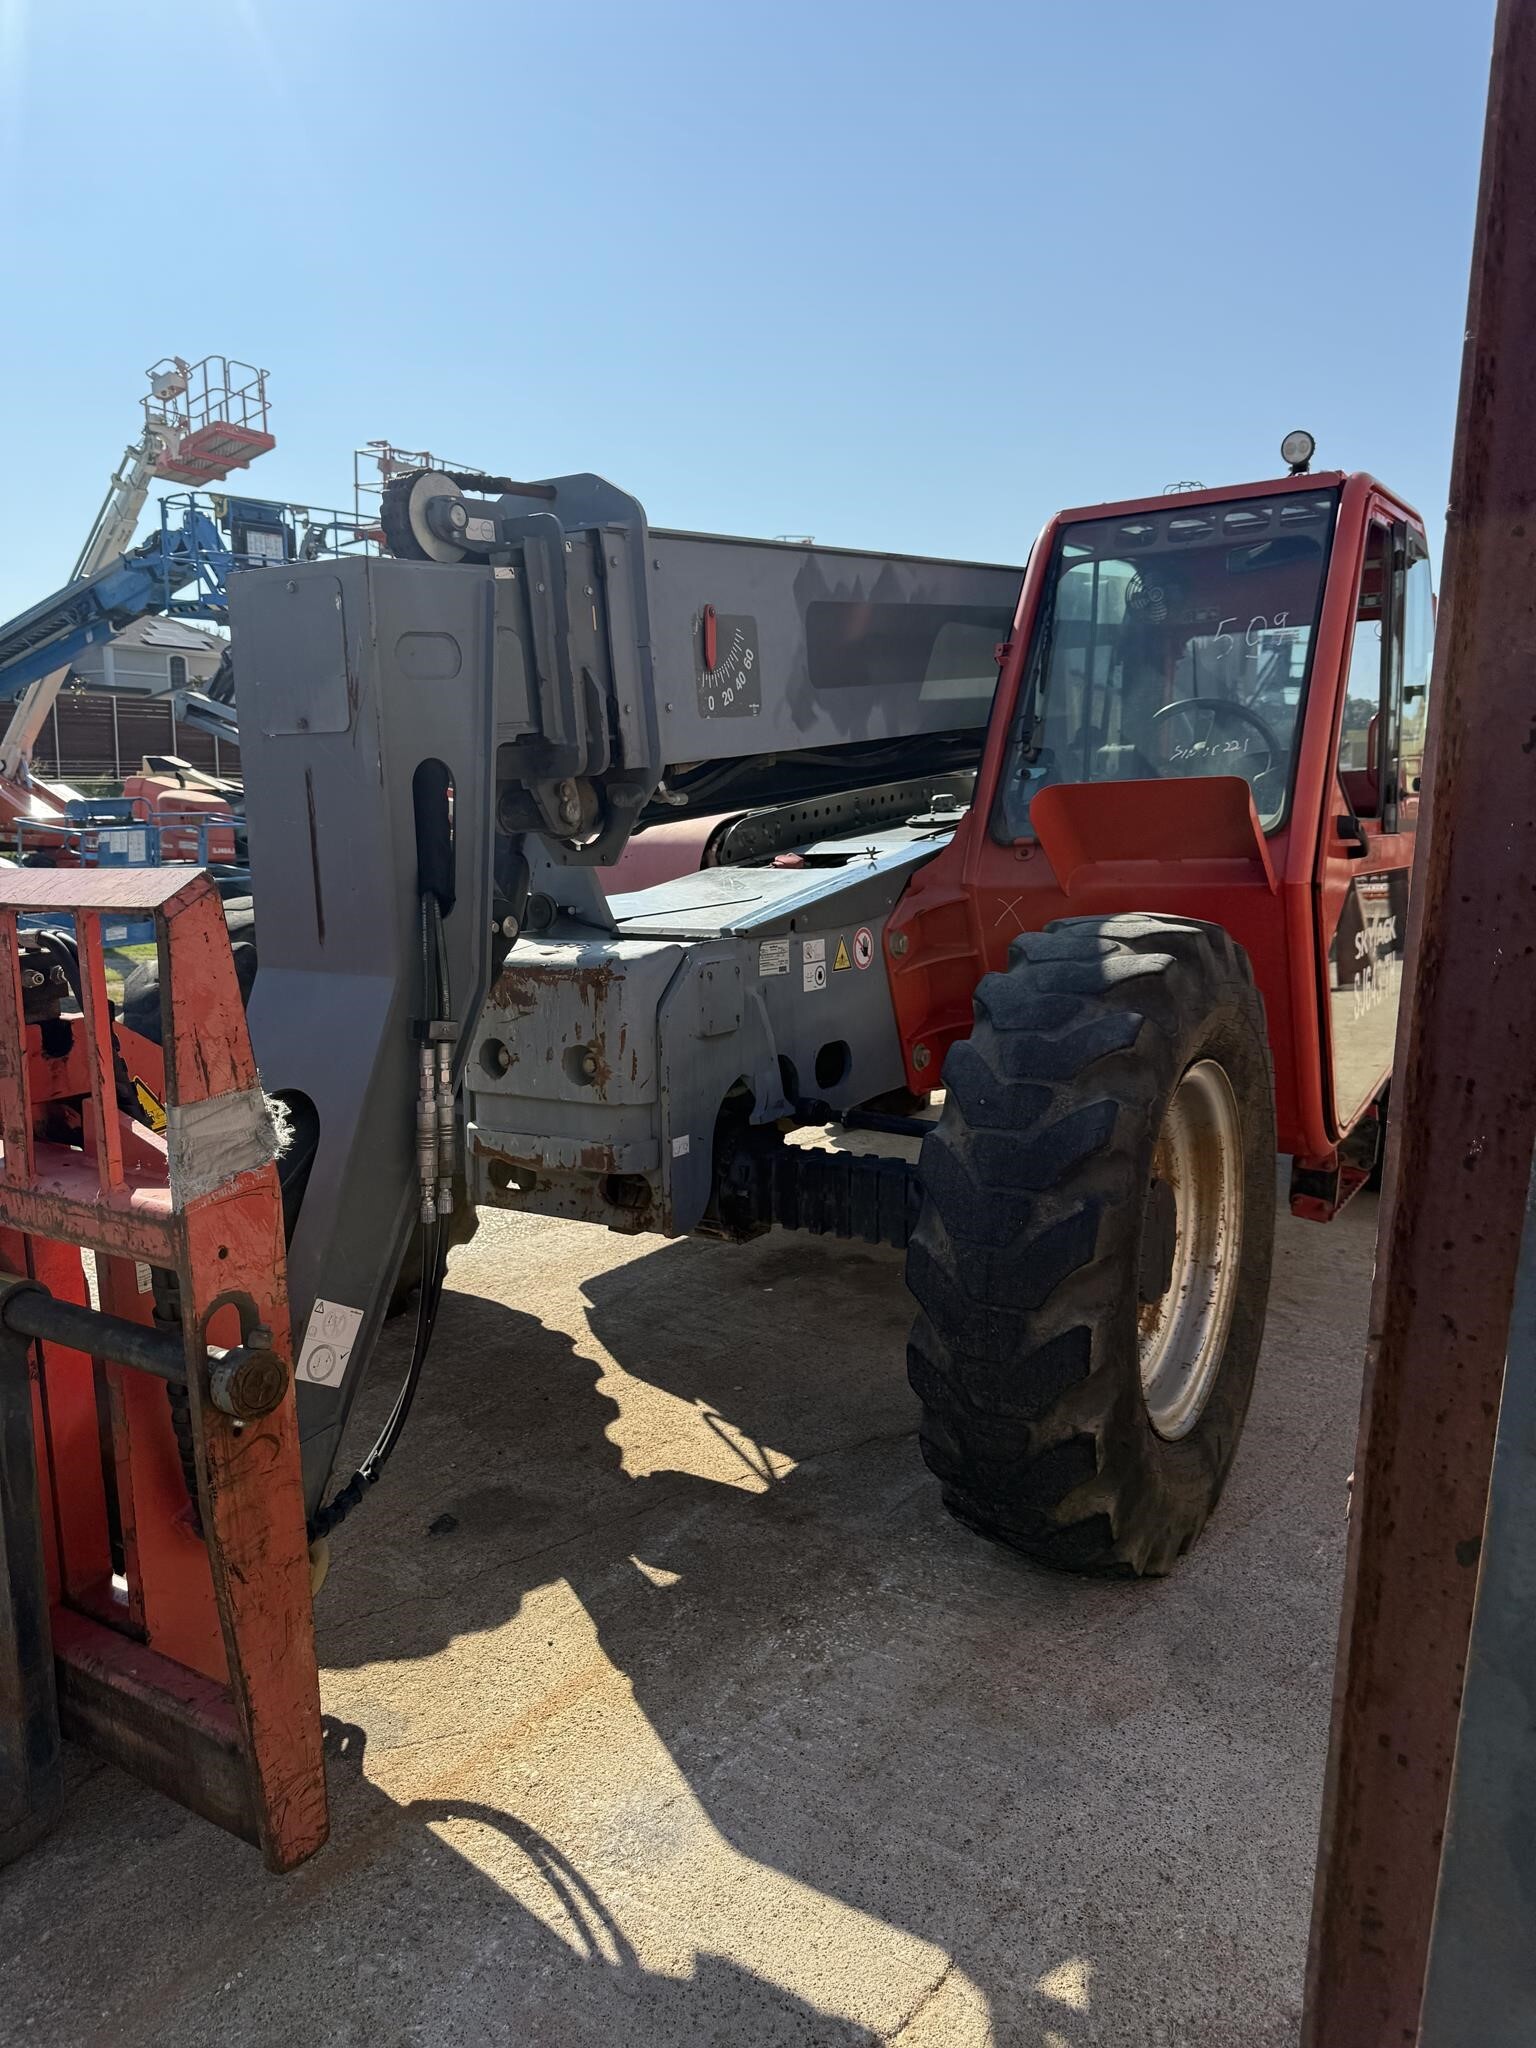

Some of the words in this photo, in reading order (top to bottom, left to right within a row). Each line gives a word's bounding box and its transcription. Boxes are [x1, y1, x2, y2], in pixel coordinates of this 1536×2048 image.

[708, 695, 715, 711] 0
[722, 687, 734, 706] 20
[735, 671, 746, 690] 40
[743, 648, 754, 670] 60
